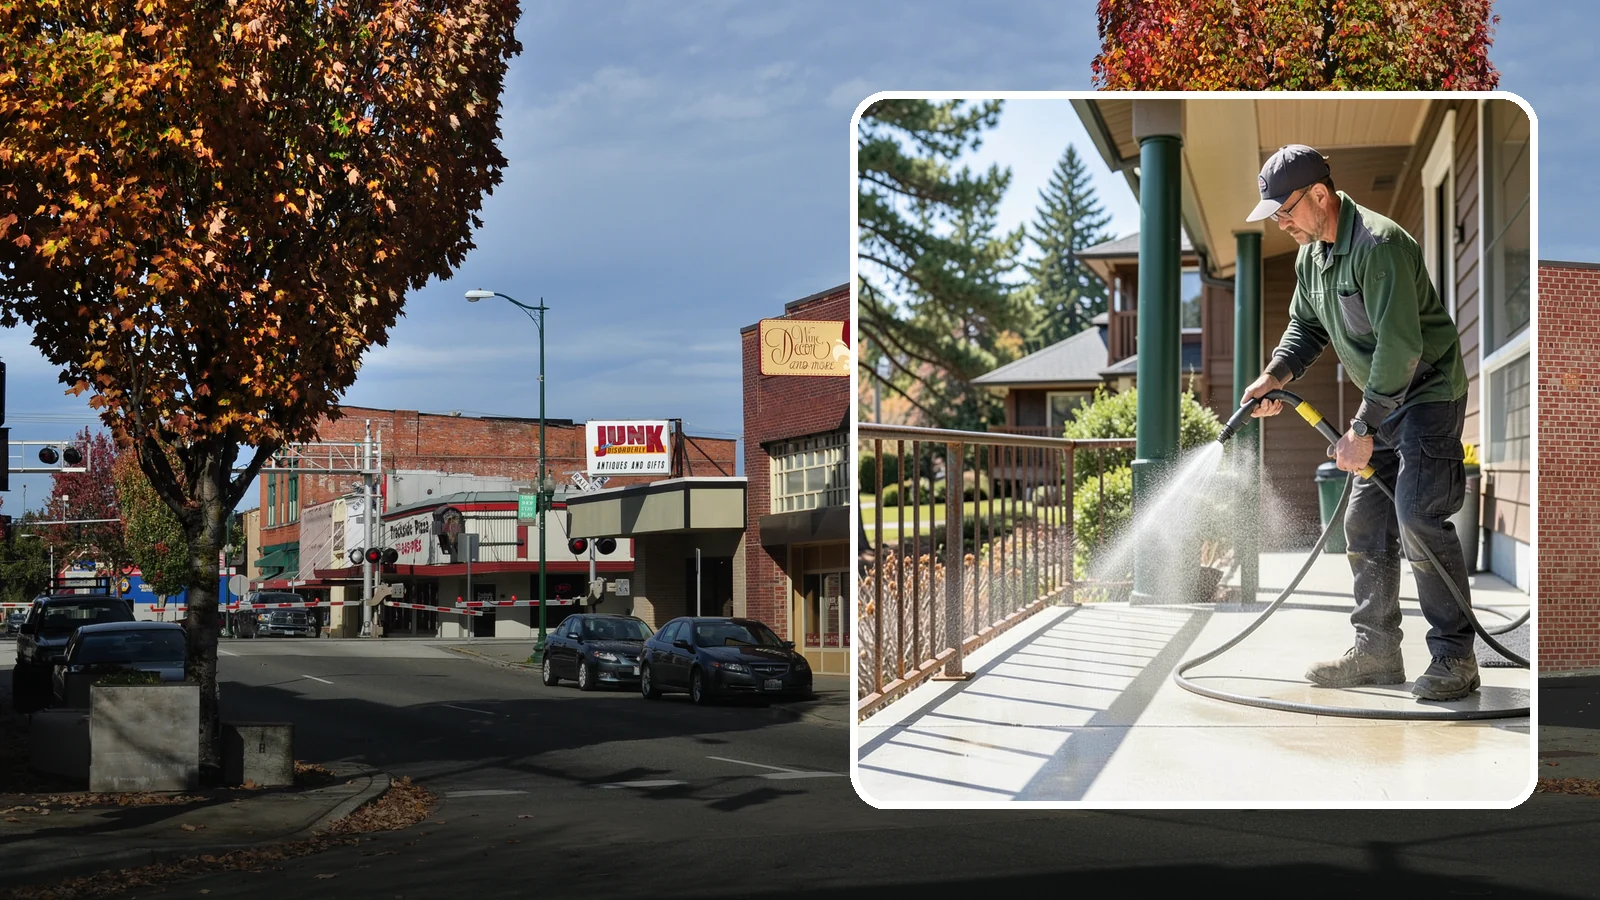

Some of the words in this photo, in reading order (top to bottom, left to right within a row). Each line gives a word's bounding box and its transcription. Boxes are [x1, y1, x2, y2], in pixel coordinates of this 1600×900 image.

[595, 425, 665, 457] JUNK
[597, 461, 628, 470] ANTIQUES
[631, 461, 643, 470] AND
[647, 461, 665, 470] GIFTS
[352, 498, 365, 511] CRO
[414, 519, 429, 534] Pizza
